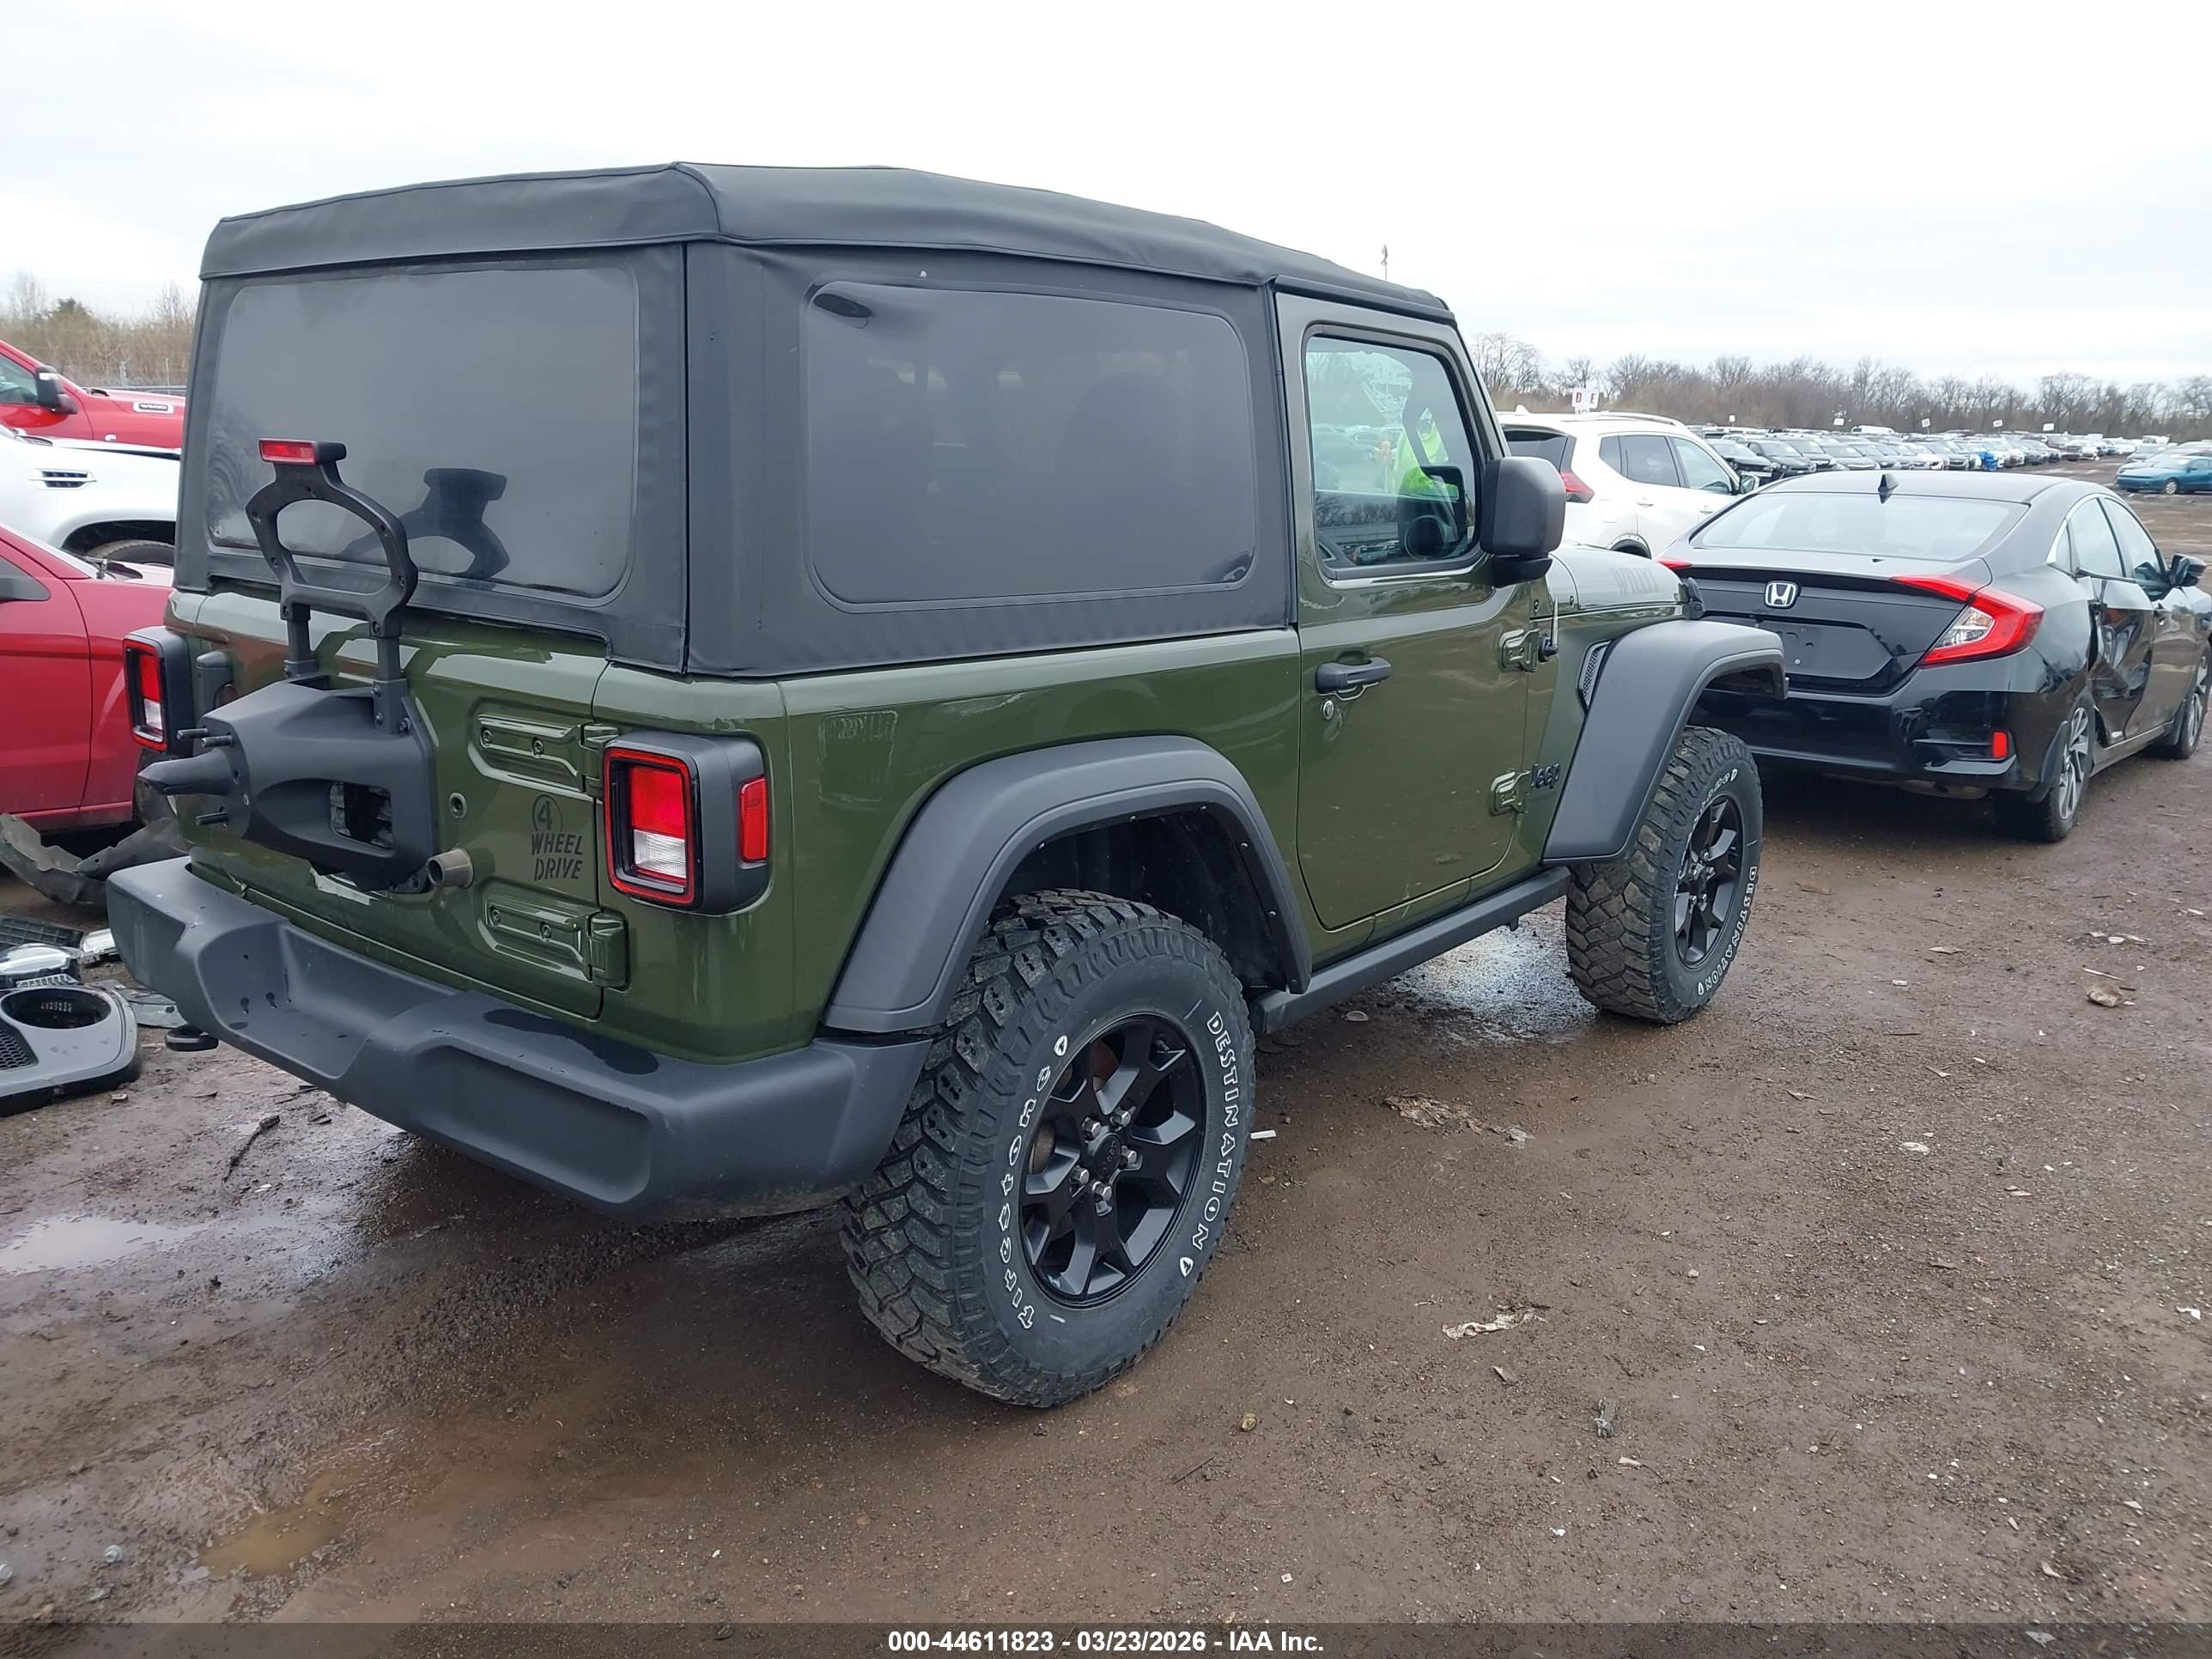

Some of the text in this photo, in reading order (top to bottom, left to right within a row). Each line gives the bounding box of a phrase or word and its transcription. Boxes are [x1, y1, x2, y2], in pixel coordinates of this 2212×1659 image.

[1575, 392, 1583, 404] D
[1531, 763, 1560, 789] Jeep
[536, 799, 553, 832] 4
[531, 832, 584, 856] WHEEL
[533, 857, 584, 882] DRIVE
[1705, 866, 1758, 992] DESTINATION
[1192, 1010, 1240, 1251] DESTINATION
[999, 1065, 1051, 1329] Firestone
